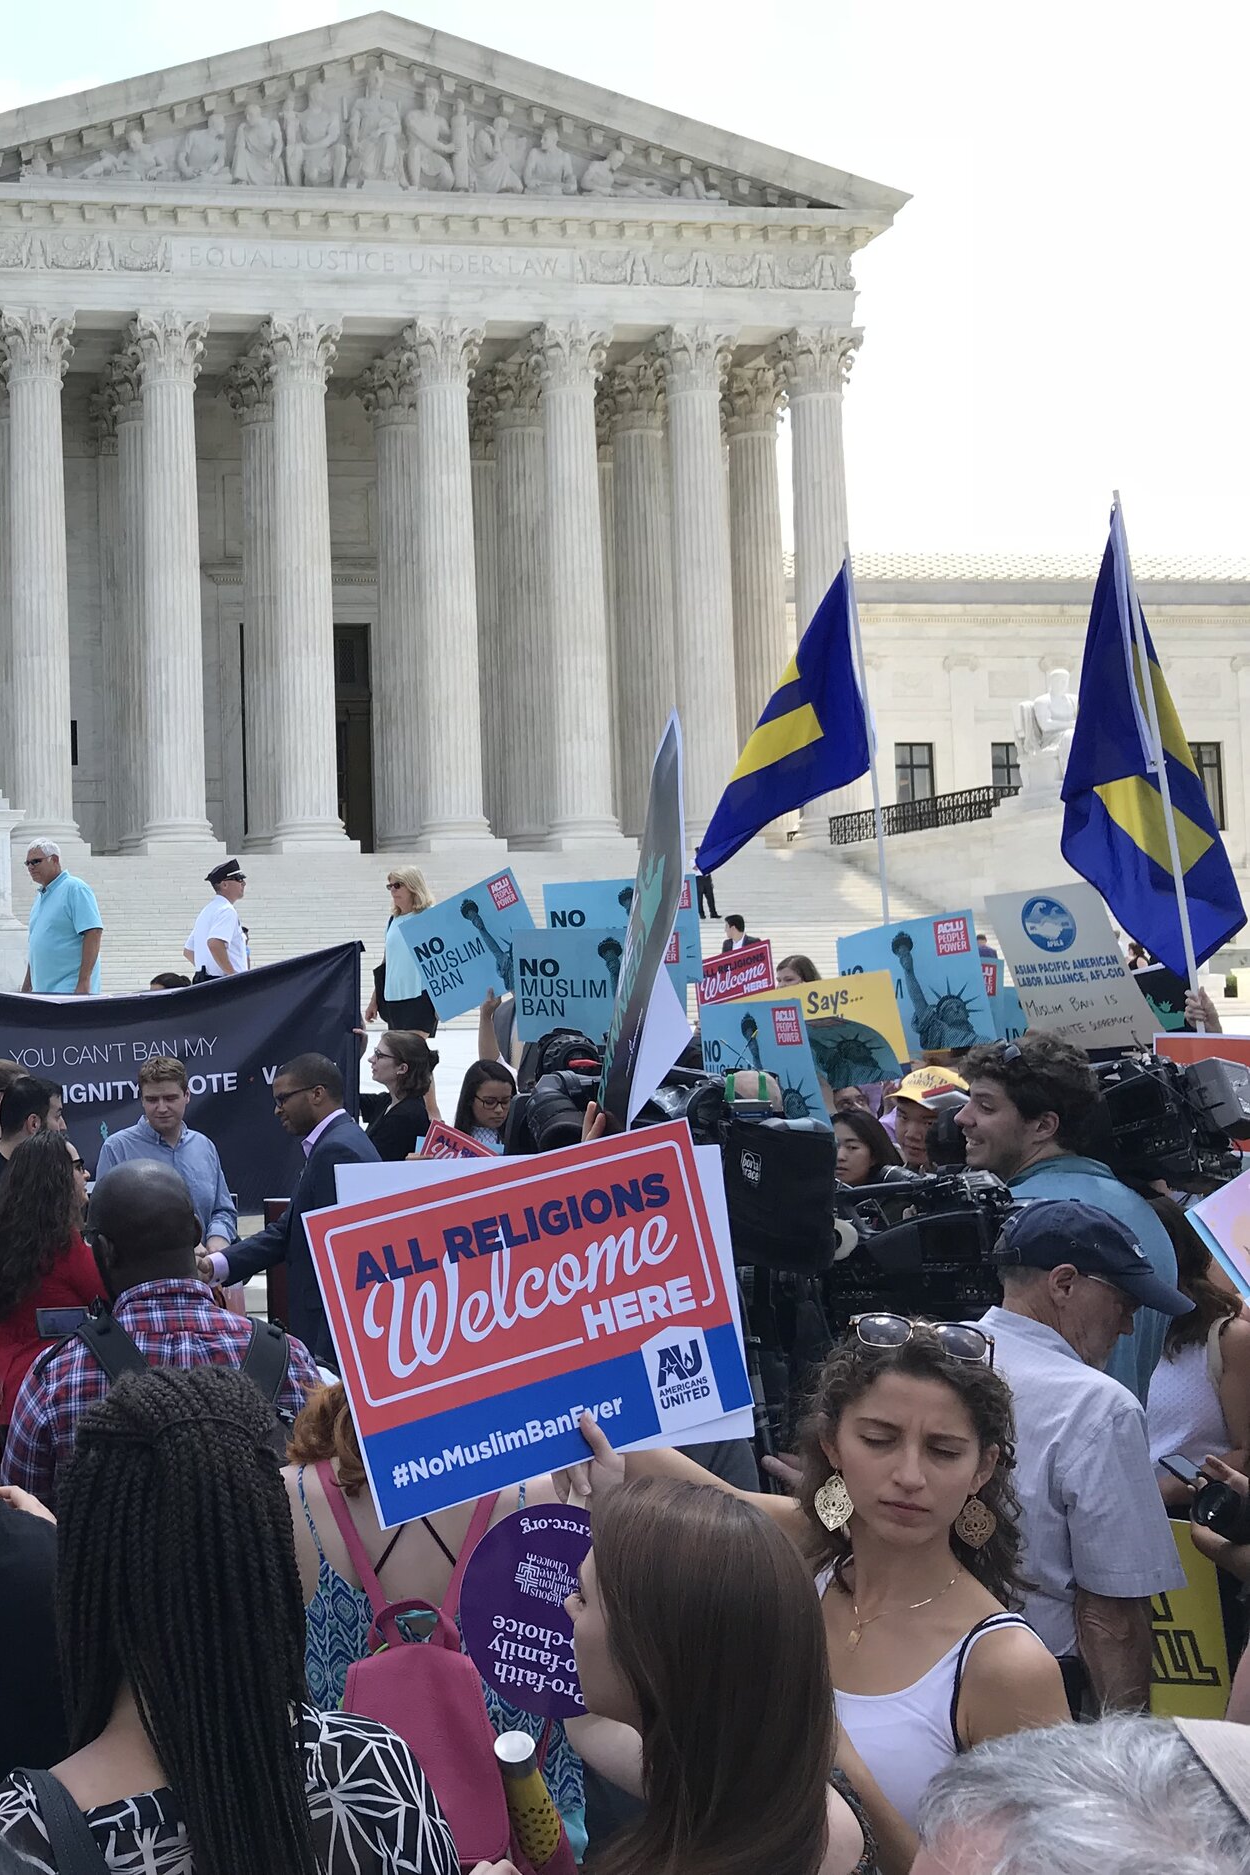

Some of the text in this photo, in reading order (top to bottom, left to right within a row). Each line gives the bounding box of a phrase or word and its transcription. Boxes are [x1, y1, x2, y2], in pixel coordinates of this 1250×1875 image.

[190, 246, 559, 277] EQUAL JUSTICE UNDER LAW
[550, 910, 586, 928] NO
[937, 920, 964, 934] ACLU
[938, 931, 966, 944] PEOPLE
[939, 940, 968, 953] POWER
[414, 936, 445, 963] NO
[421, 937, 486, 980] MUSLIM
[519, 958, 560, 977] NO
[1014, 955, 1119, 975] ASIAN PACIFIC AMERICAN
[429, 969, 464, 998] BAN
[701, 963, 766, 1001] Welcome
[743, 979, 768, 994] HERE
[1017, 967, 1125, 987] LABOR ALLIANCE, AFL-CIO
[521, 979, 607, 998] MUSLIM
[522, 999, 565, 1017] BAN
[775, 1010, 796, 1022] ACLU
[776, 1022, 799, 1032] PEOPLE
[778, 1032, 800, 1043] POWER
[9, 1047, 56, 1068] YOU
[132, 1039, 178, 1061] BAN
[184, 1036, 218, 1057] MY
[704, 1040, 722, 1062] NO
[63, 1080, 139, 1104] IGNITY
[189, 1072, 238, 1096] OTE
[355, 1173, 670, 1291] ALL RELIGIONS
[363, 1215, 679, 1379] Welcome
[582, 1275, 697, 1341] HERE
[659, 1377, 709, 1398] AMERICANS
[661, 1388, 711, 1410] UNITED
[392, 1396, 623, 1489] #NoMuslimBanEver
[520, 1517, 591, 1538] .rcrc.org
[537, 1555, 569, 1574] Choice
[538, 1577, 578, 1596] oalition
[539, 1567, 579, 1586] oductive
[531, 1587, 565, 1608] eligious
[488, 1632, 579, 1673] o-family
